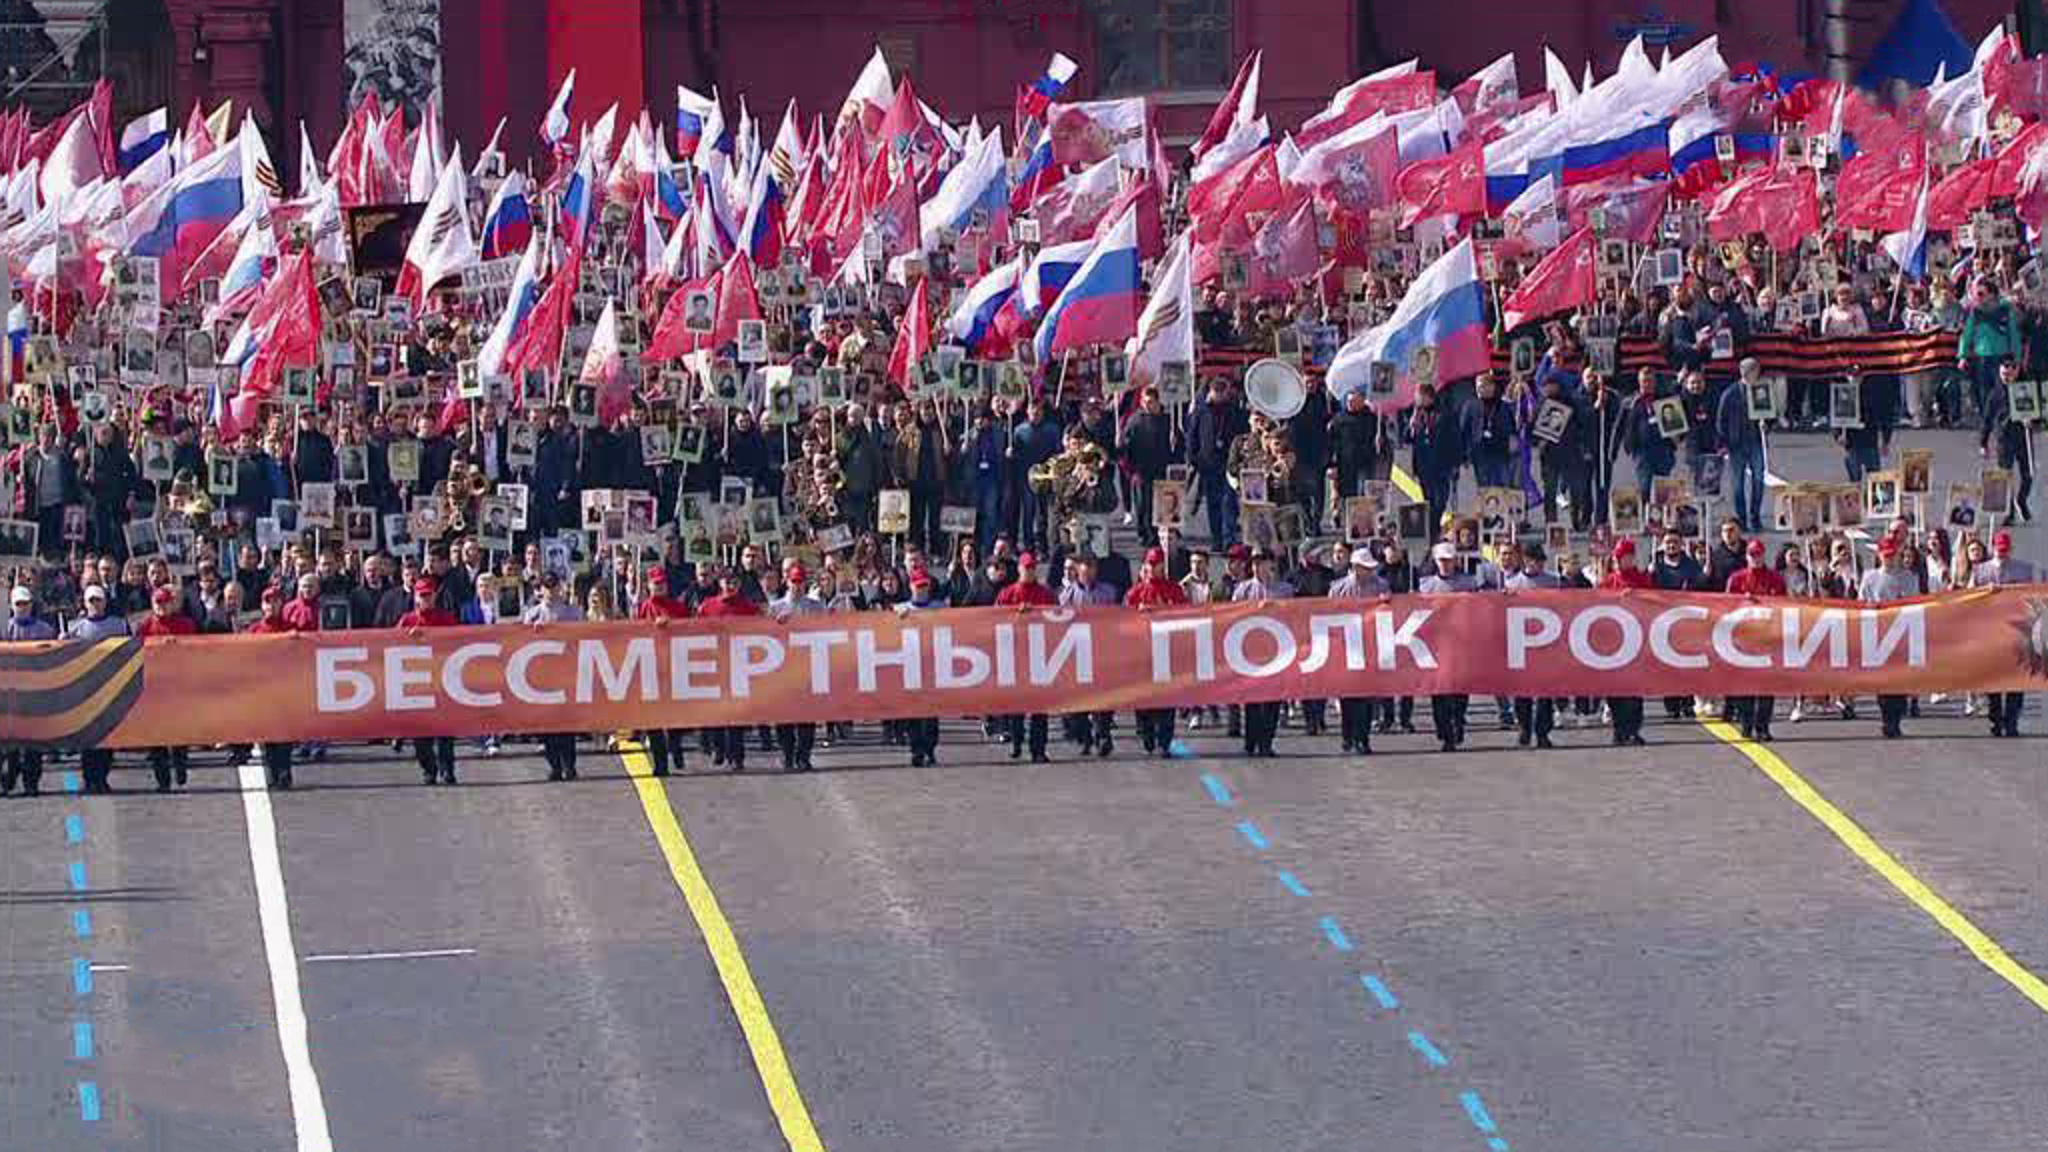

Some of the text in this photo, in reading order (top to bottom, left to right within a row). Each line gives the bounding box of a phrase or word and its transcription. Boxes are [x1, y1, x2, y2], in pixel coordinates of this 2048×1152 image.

[315, 604, 1927, 712] БЕССМЕРТНЫЙ ПОЛК РОССИИ
